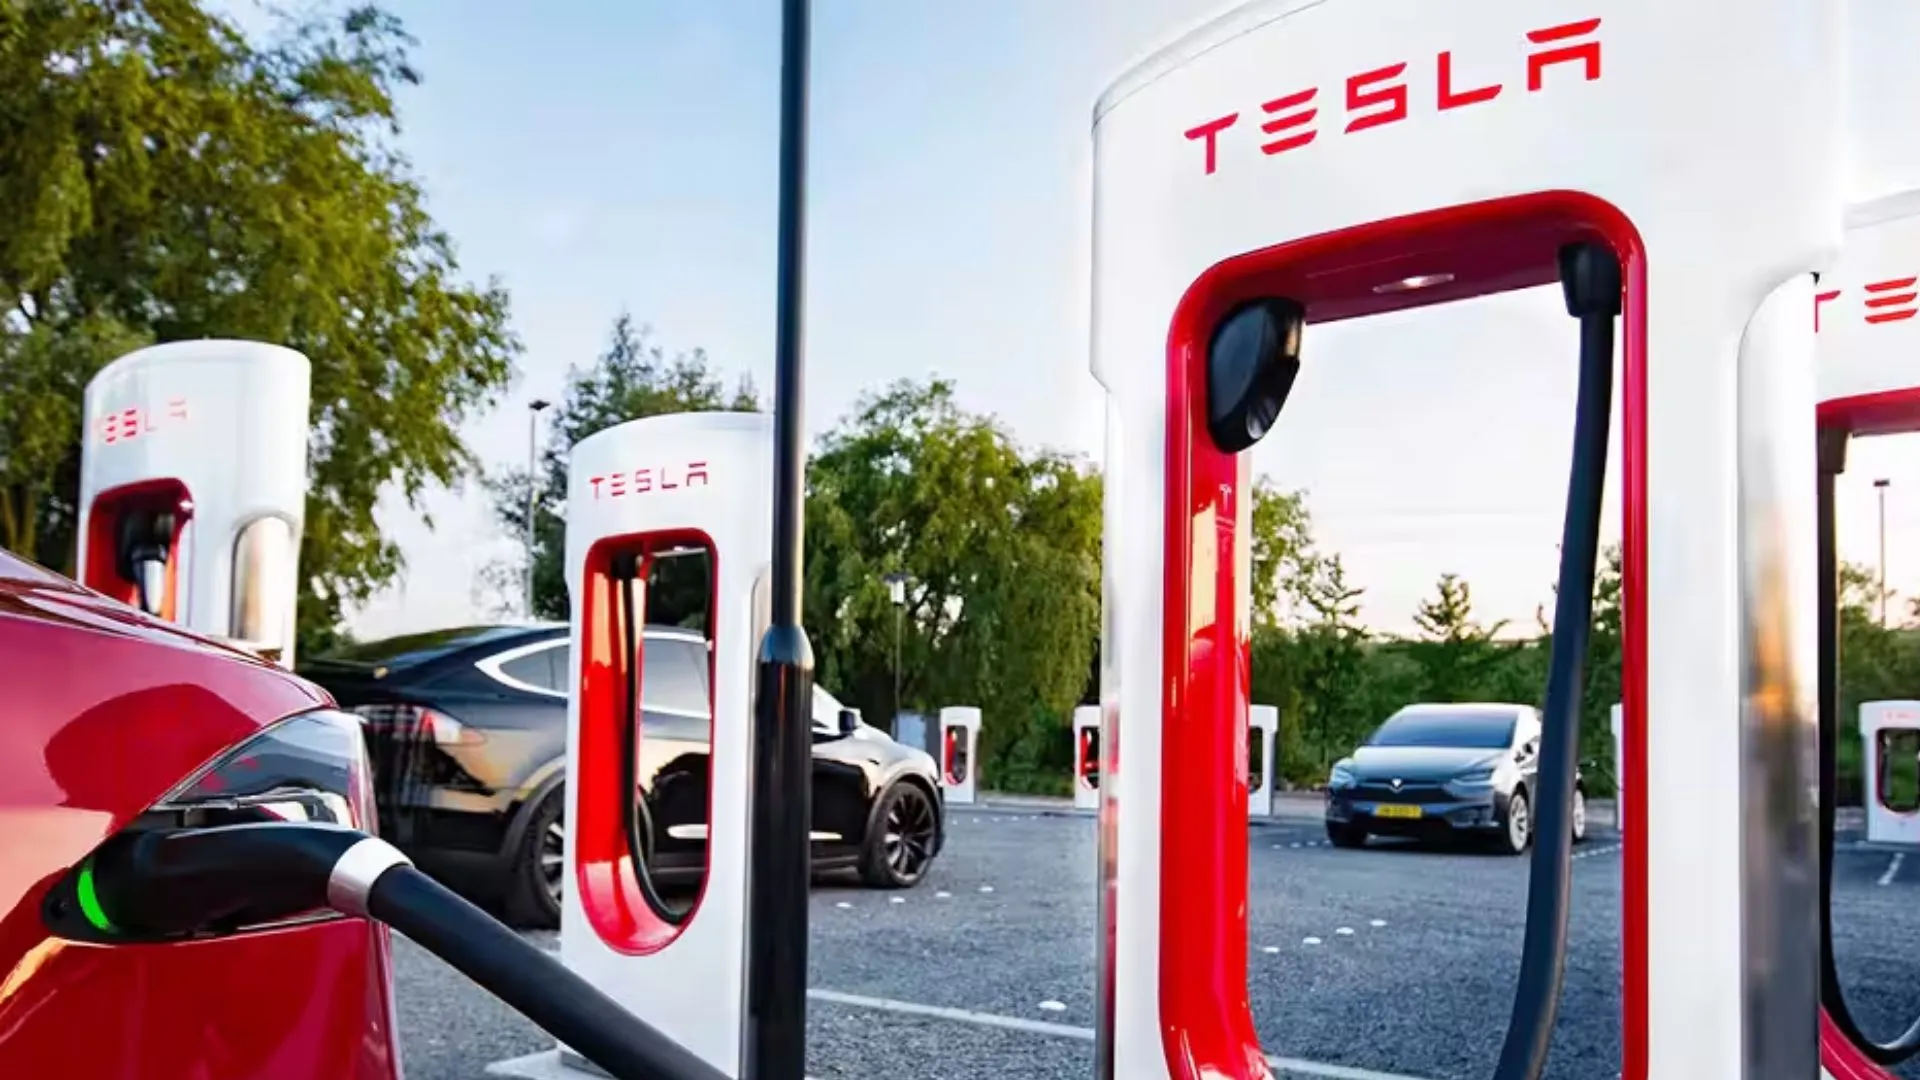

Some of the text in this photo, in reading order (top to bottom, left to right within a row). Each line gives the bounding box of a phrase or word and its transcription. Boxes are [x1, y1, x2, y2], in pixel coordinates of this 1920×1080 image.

[1184, 17, 1602, 175] TESLA
[94, 400, 187, 443] ESLA
[590, 461, 708, 500] TESLA
